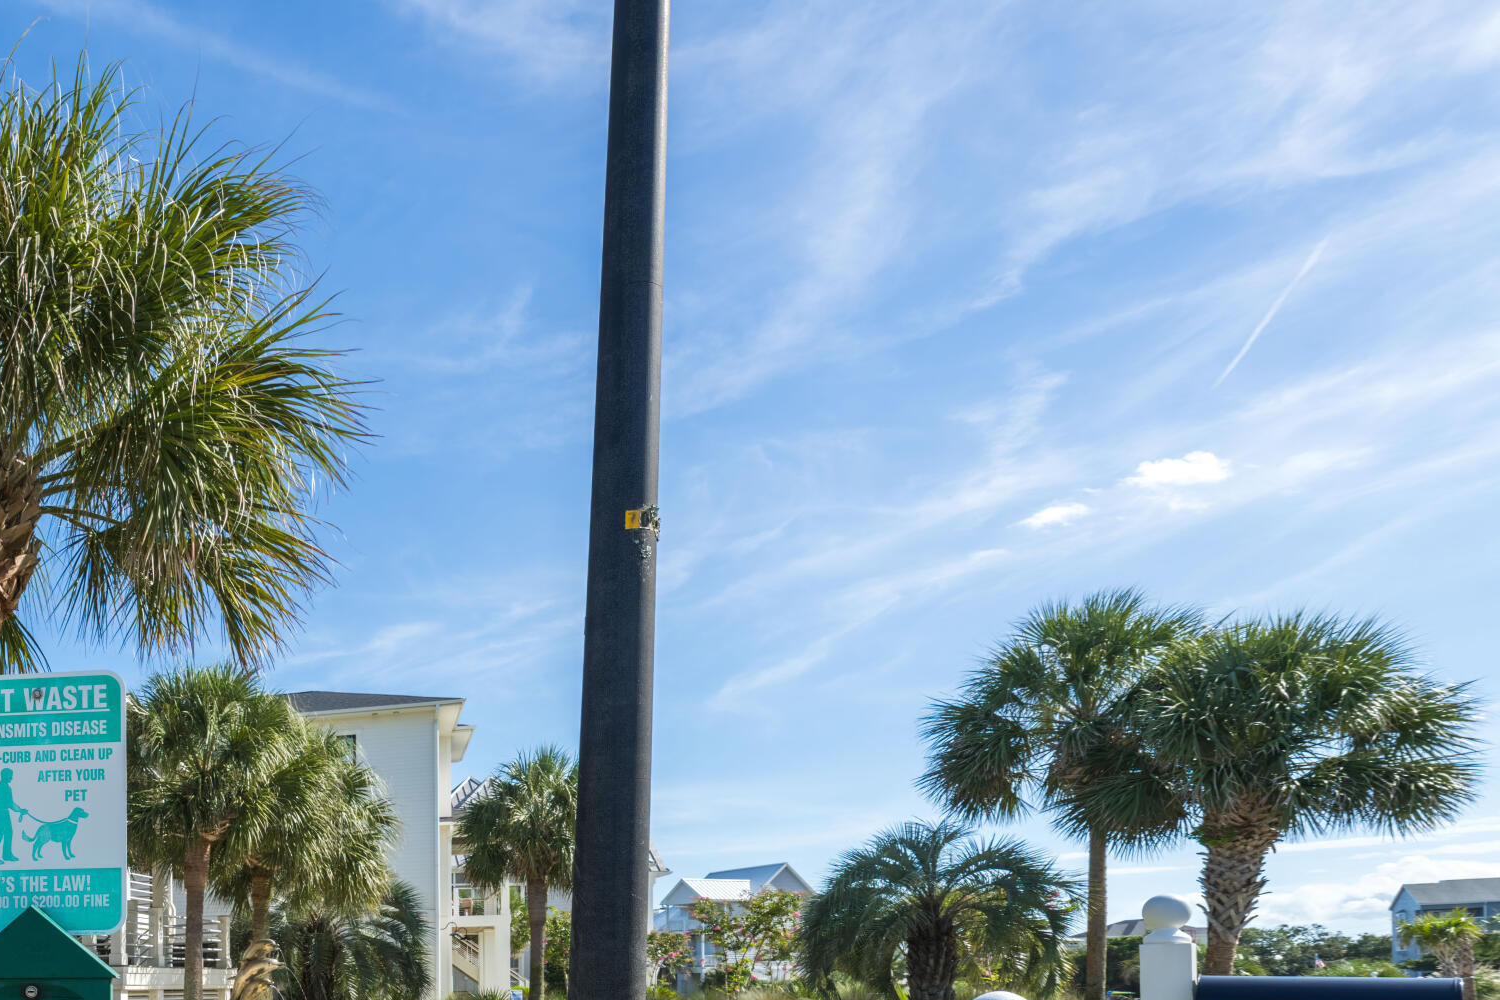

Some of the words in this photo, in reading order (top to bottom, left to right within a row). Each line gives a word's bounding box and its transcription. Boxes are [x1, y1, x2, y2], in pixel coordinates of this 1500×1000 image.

[23, 684, 108, 712] WASTE
[51, 720, 107, 737] DISEASE
[34, 749, 57, 763] AND
[60, 748, 96, 762] CLEAN
[97, 747, 113, 760] UP
[37, 769, 72, 783] AFTER
[74, 768, 105, 782] YOUR
[64, 789, 88, 802] PET
[19, 875, 49, 893] THE
[53, 874, 92, 892] LAW!
[12, 895, 28, 909] TO
[31, 894, 79, 908] $200.00
[83, 893, 110, 908] FINE
